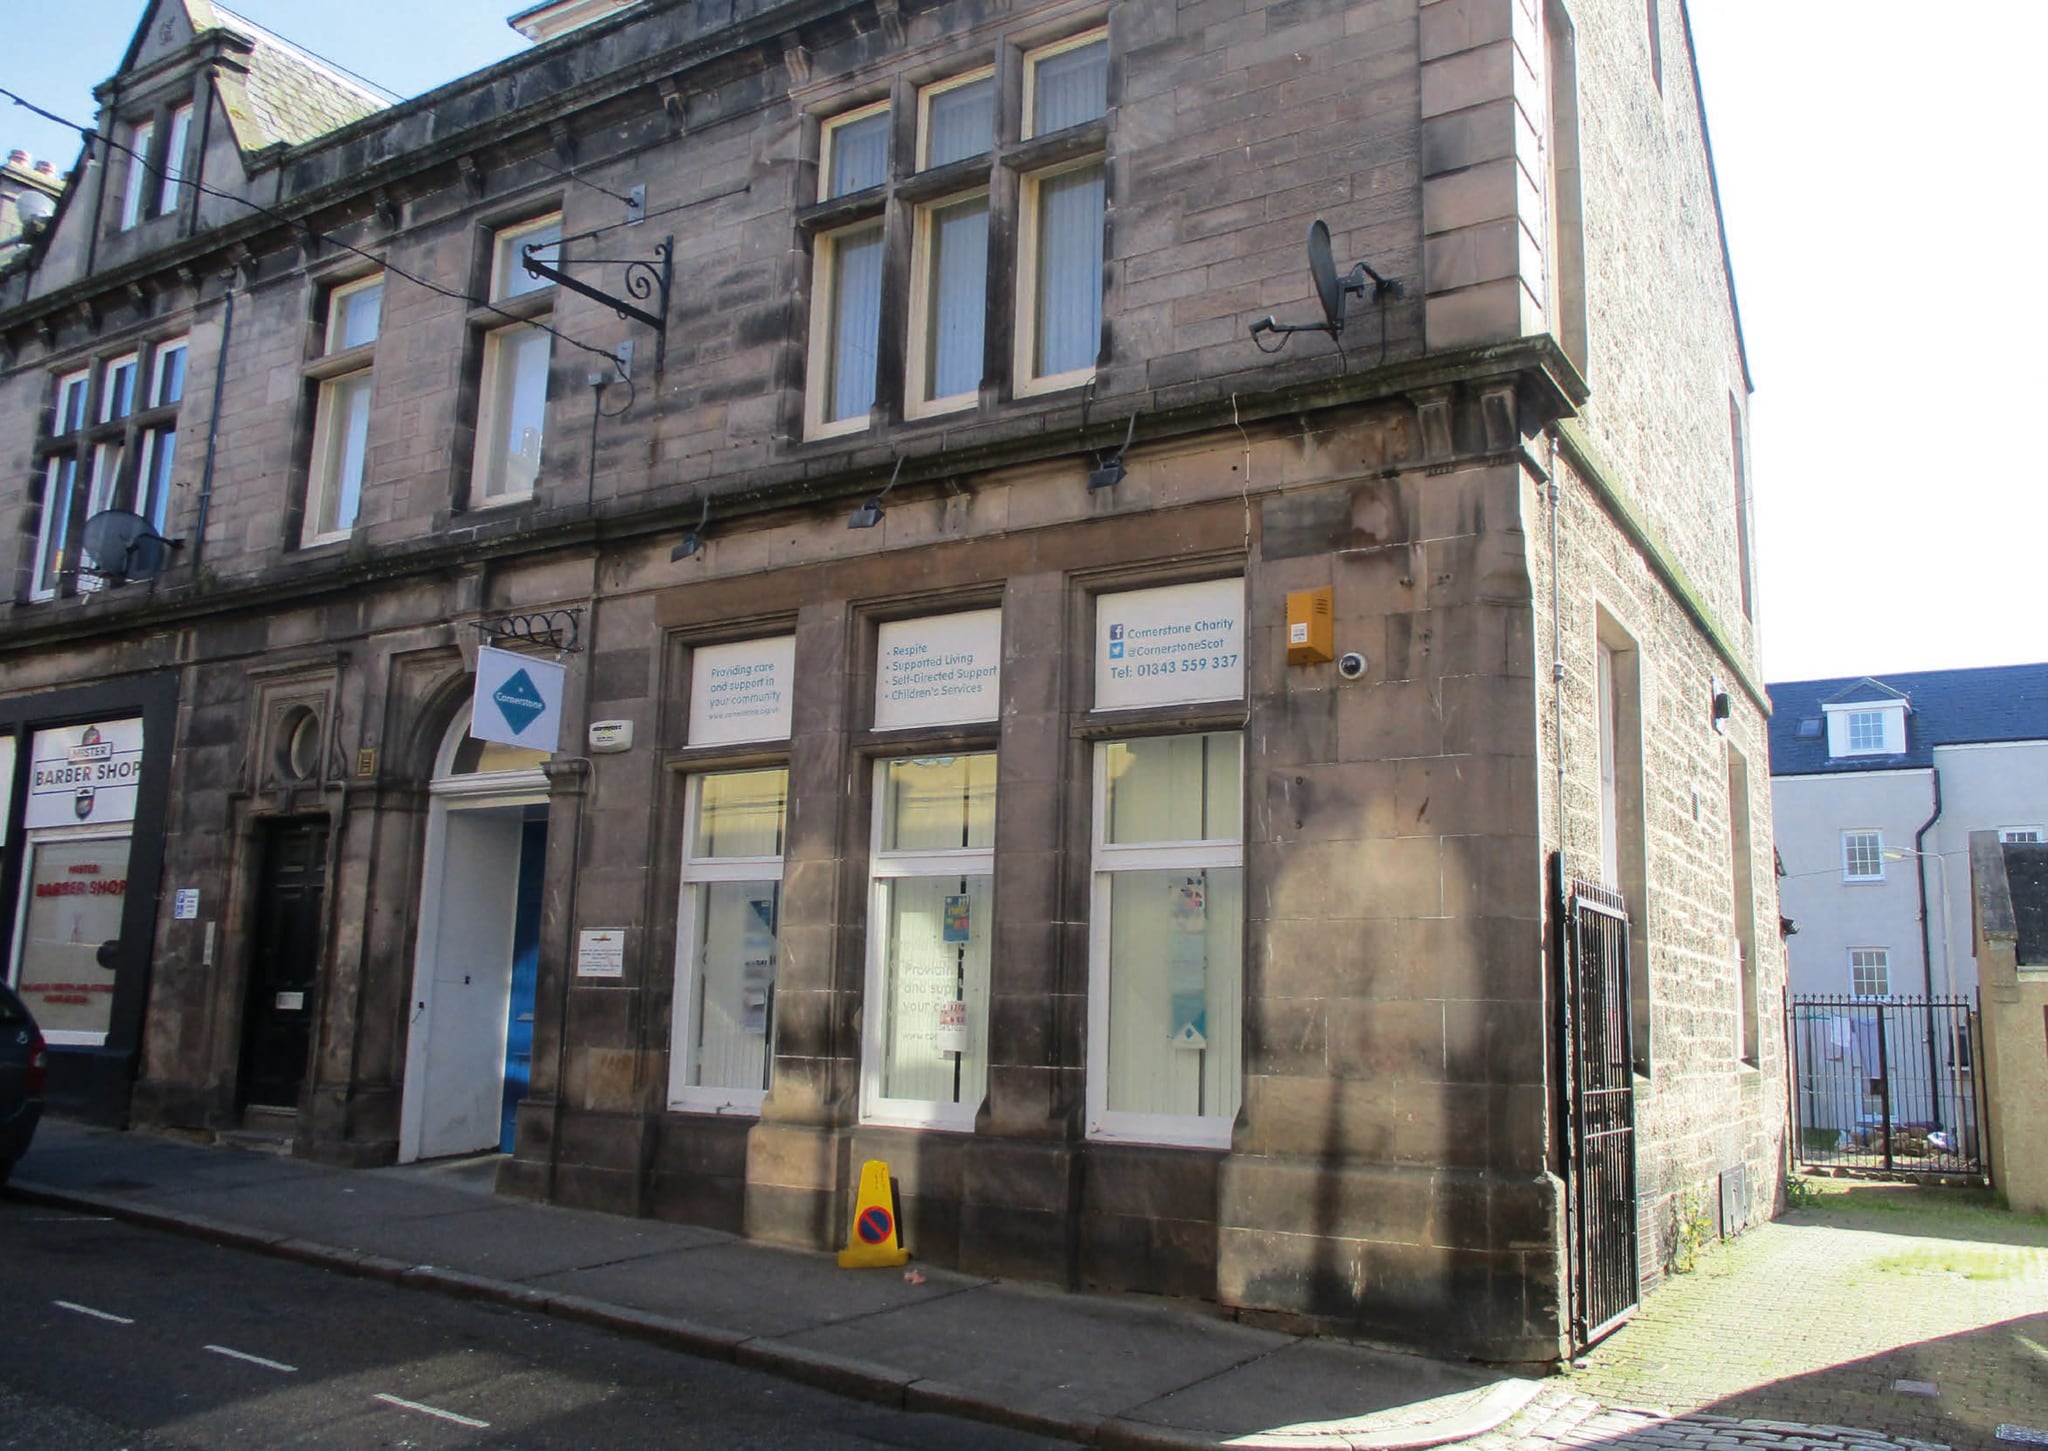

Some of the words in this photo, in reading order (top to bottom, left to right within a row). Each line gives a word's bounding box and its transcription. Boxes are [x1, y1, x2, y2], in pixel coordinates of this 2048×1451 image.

[1128, 625, 1192, 640] Cornerstone
[1194, 618, 1234, 633] Charity
[893, 643, 928, 657] Respite
[1128, 638, 1224, 658] @CornerstoneScot
[711, 665, 752, 678] Providing
[754, 663, 775, 672] care
[892, 657, 942, 672] Supported
[945, 653, 974, 666] Living
[1111, 665, 1133, 679] Tel:
[1137, 661, 1176, 677] 01343
[1181, 658, 1206, 673] 559
[1212, 654, 1238, 669] 337
[710, 681, 727, 692] and
[730, 678, 764, 692] support
[765, 677, 775, 687] in
[892, 671, 954, 686] Self-Directed
[957, 665, 998, 680] Support
[495, 691, 543, 708] Cornerstone
[709, 696, 730, 709] your
[732, 691, 781, 705] community
[892, 688, 939, 701] Children's
[941, 683, 983, 696] Services
[71, 746, 107, 758] MISTER
[35, 765, 92, 786] BARBER
[96, 760, 141, 781] SHOP
[36, 881, 88, 897] BARBER
[88, 878, 128, 896] SHOP
